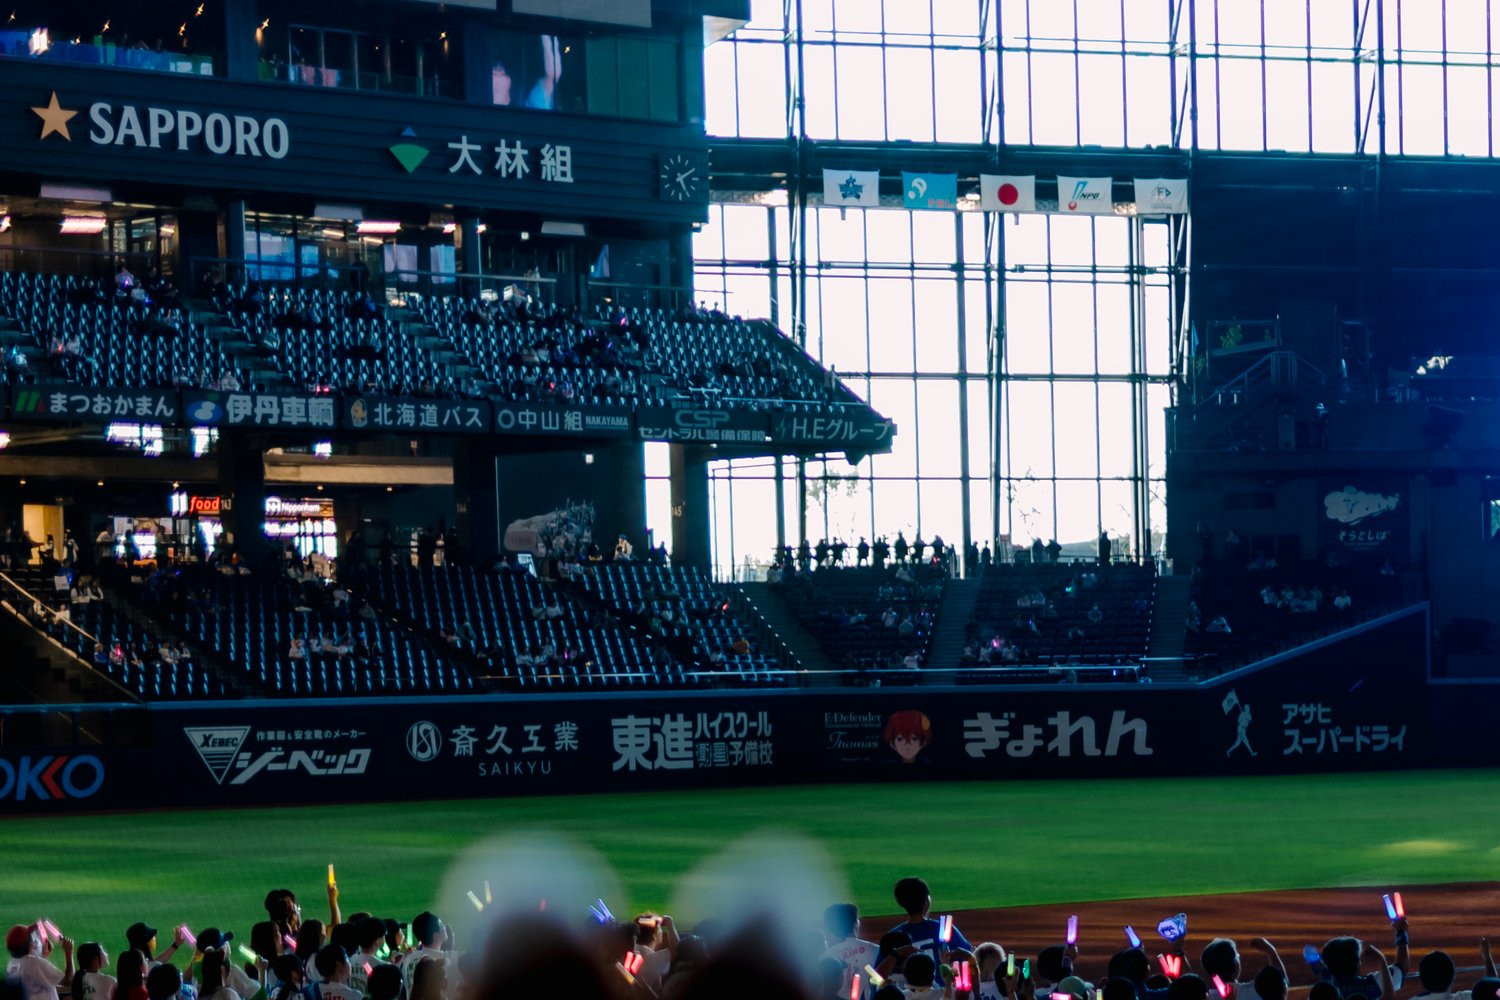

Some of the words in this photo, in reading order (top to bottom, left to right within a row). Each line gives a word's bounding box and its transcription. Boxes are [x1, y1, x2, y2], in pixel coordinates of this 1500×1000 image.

[89, 102, 290, 159] SAPPORO
[447, 134, 574, 183] 大林組
[49, 393, 175, 418] まつおかまん
[374, 403, 483, 428] 北海道バス
[518, 409, 584, 431] 中山組
[585, 416, 629, 426] NAKAYAMA
[675, 410, 730, 427] CSP
[190, 496, 221, 514] food
[1282, 703, 1331, 724] アサヒ
[611, 712, 694, 772] 東進
[695, 711, 773, 739] ハイスクール
[963, 710, 1154, 758] ぎょれん
[1282, 725, 1407, 757] スーパードライ
[229, 746, 372, 785] ジーベック
[478, 760, 552, 777] SAIKYU
